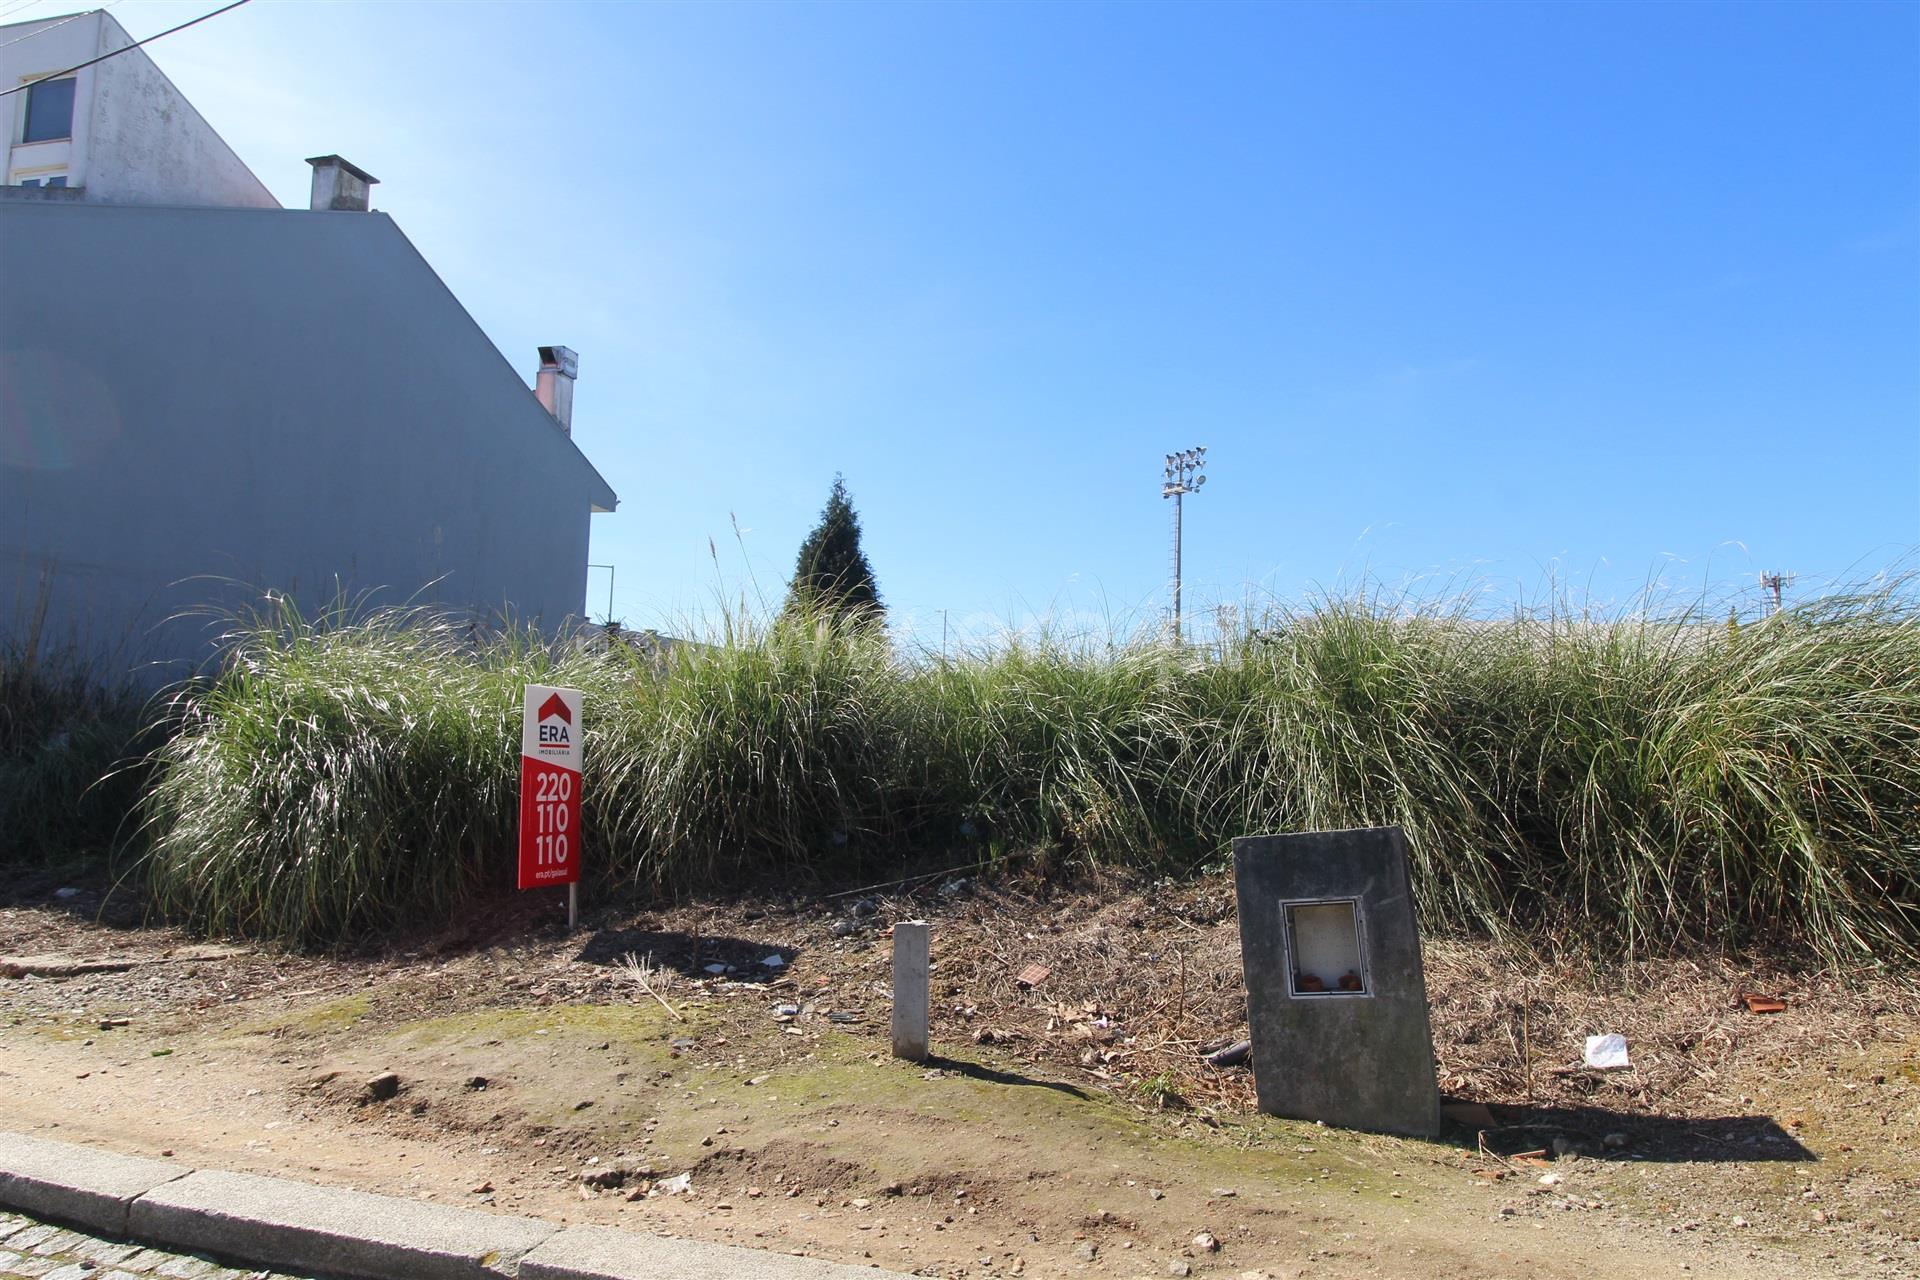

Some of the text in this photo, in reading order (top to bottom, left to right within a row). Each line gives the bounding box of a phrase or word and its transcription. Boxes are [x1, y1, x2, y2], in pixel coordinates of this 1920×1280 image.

[539, 725, 570, 742] ERA
[536, 772, 571, 801] 220
[537, 803, 568, 833] 110
[536, 834, 568, 865] 110
